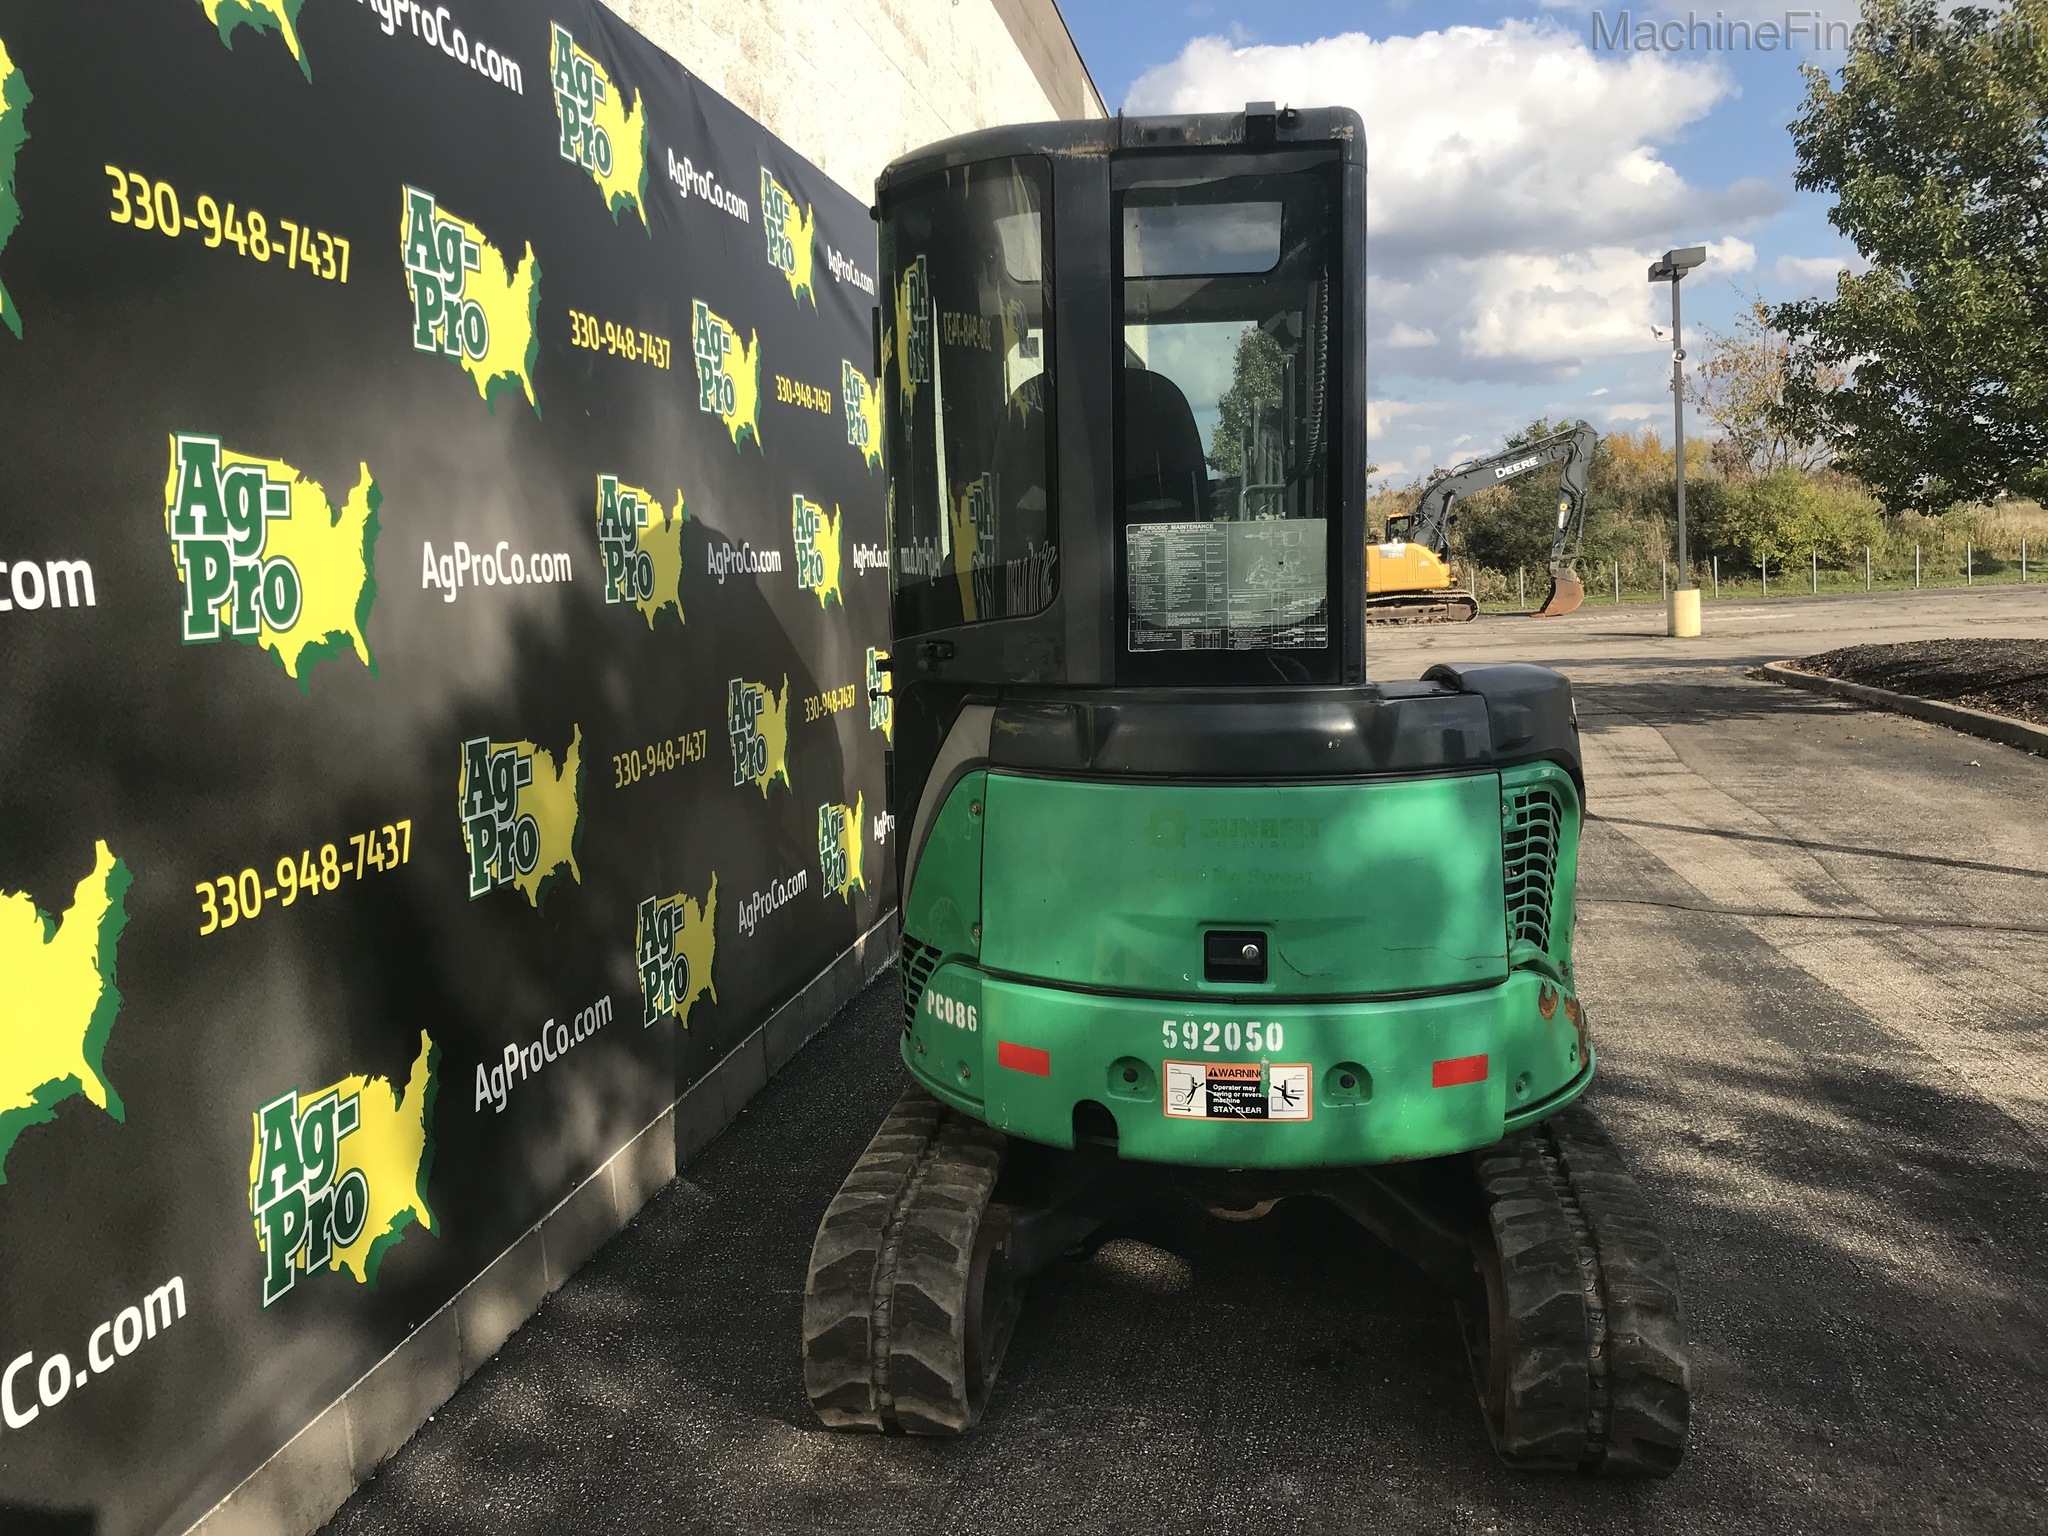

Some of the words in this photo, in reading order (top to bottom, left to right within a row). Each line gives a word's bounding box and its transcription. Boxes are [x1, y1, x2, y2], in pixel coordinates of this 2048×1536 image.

[554, 23, 606, 119] Ag-
[558, 98, 613, 177] Pro
[668, 147, 749, 224] AgProCo.com
[761, 167, 791, 227] Ag-
[105, 165, 350, 284] 330-948-7437
[404, 186, 481, 298] Ag-
[766, 216, 796, 275] Pro
[827, 245, 875, 296] AgProCo.com
[411, 268, 489, 360] Pro
[569, 310, 671, 371] 330-948-7437
[693, 300, 731, 371] Ag-
[699, 356, 737, 416] Pro
[776, 376, 832, 415] 330-948-7437
[845, 402, 869, 447] Pro
[170, 436, 292, 560] Ag-
[1494, 456, 1539, 480] DEERE
[599, 474, 648, 550] Ag-
[793, 494, 820, 553] Ag-
[181, 538, 302, 641] Pro
[421, 541, 573, 604] AgProCo.com
[602, 537, 655, 605] Pro
[706, 541, 783, 585] AgProCo.com
[796, 541, 824, 590] Pro
[729, 678, 764, 742] Ag-
[804, 685, 856, 723] 330-948-7437
[464, 736, 533, 822] Ag-
[612, 730, 708, 789] 330-948-7437
[733, 730, 769, 787] Pro
[467, 815, 541, 898] Pro
[820, 803, 845, 855] Ag-
[195, 819, 412, 936] 330-948-7437
[738, 869, 808, 937] AgProCo.com
[821, 849, 847, 898] Pro
[639, 896, 685, 971] Ag-
[643, 954, 689, 1029] Pro
[927, 988, 978, 1032] PC086
[474, 994, 614, 1114] AgProCo.com
[1162, 1019, 1284, 1053] 592050
[1212, 1083, 1241, 1092] Operator
[1217, 1068, 1261, 1078] WARNIN
[1212, 1105, 1234, 1113] STAY
[1234, 1106, 1262, 1114] CLEAR
[255, 1090, 360, 1213] Ag-
[262, 1170, 369, 1308] Pro
[0, 1275, 187, 1430] Co.com
